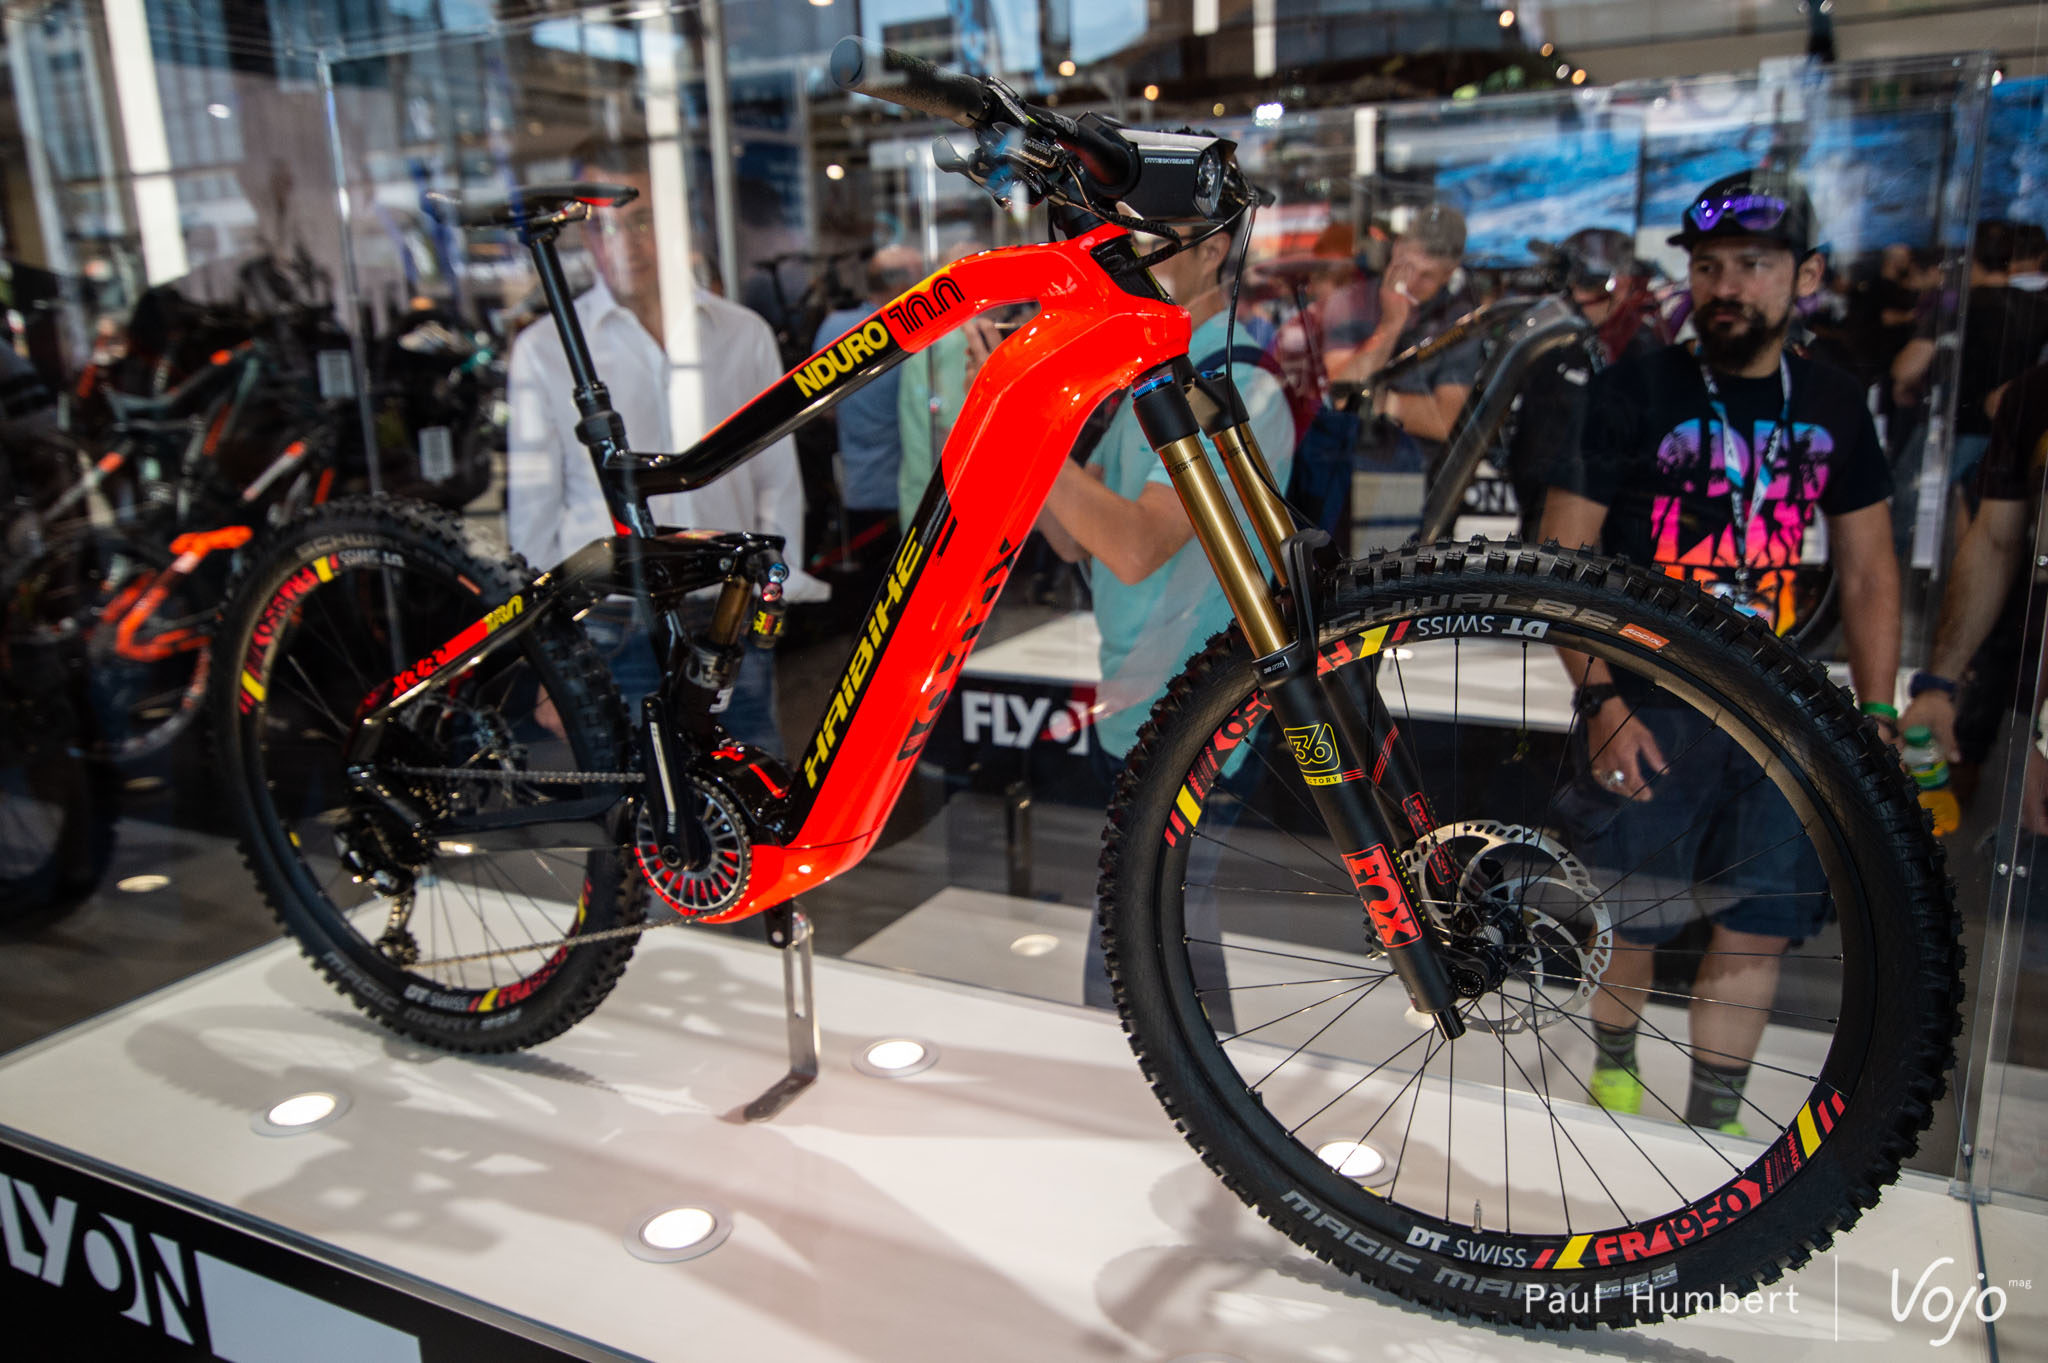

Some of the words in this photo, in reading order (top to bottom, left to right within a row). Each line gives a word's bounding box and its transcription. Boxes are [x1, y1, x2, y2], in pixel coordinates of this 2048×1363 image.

[793, 321, 889, 398] NDURO
[1320, 593, 1619, 633] CHWALBE
[1417, 615, 1495, 636] SWISS
[1501, 620, 1550, 639] DT
[961, 690, 1090, 756] FLYO
[1285, 723, 1339, 769] 36
[1306, 775, 1338, 785] CTORY
[1348, 847, 1420, 945] FOX
[1280, 1190, 1422, 1274] MAGIC
[1406, 1226, 1450, 1252] DT
[1453, 1238, 1527, 1269] SWISS
[0, 1171, 195, 1345] LYON
[1433, 1266, 1582, 1302] MARY
